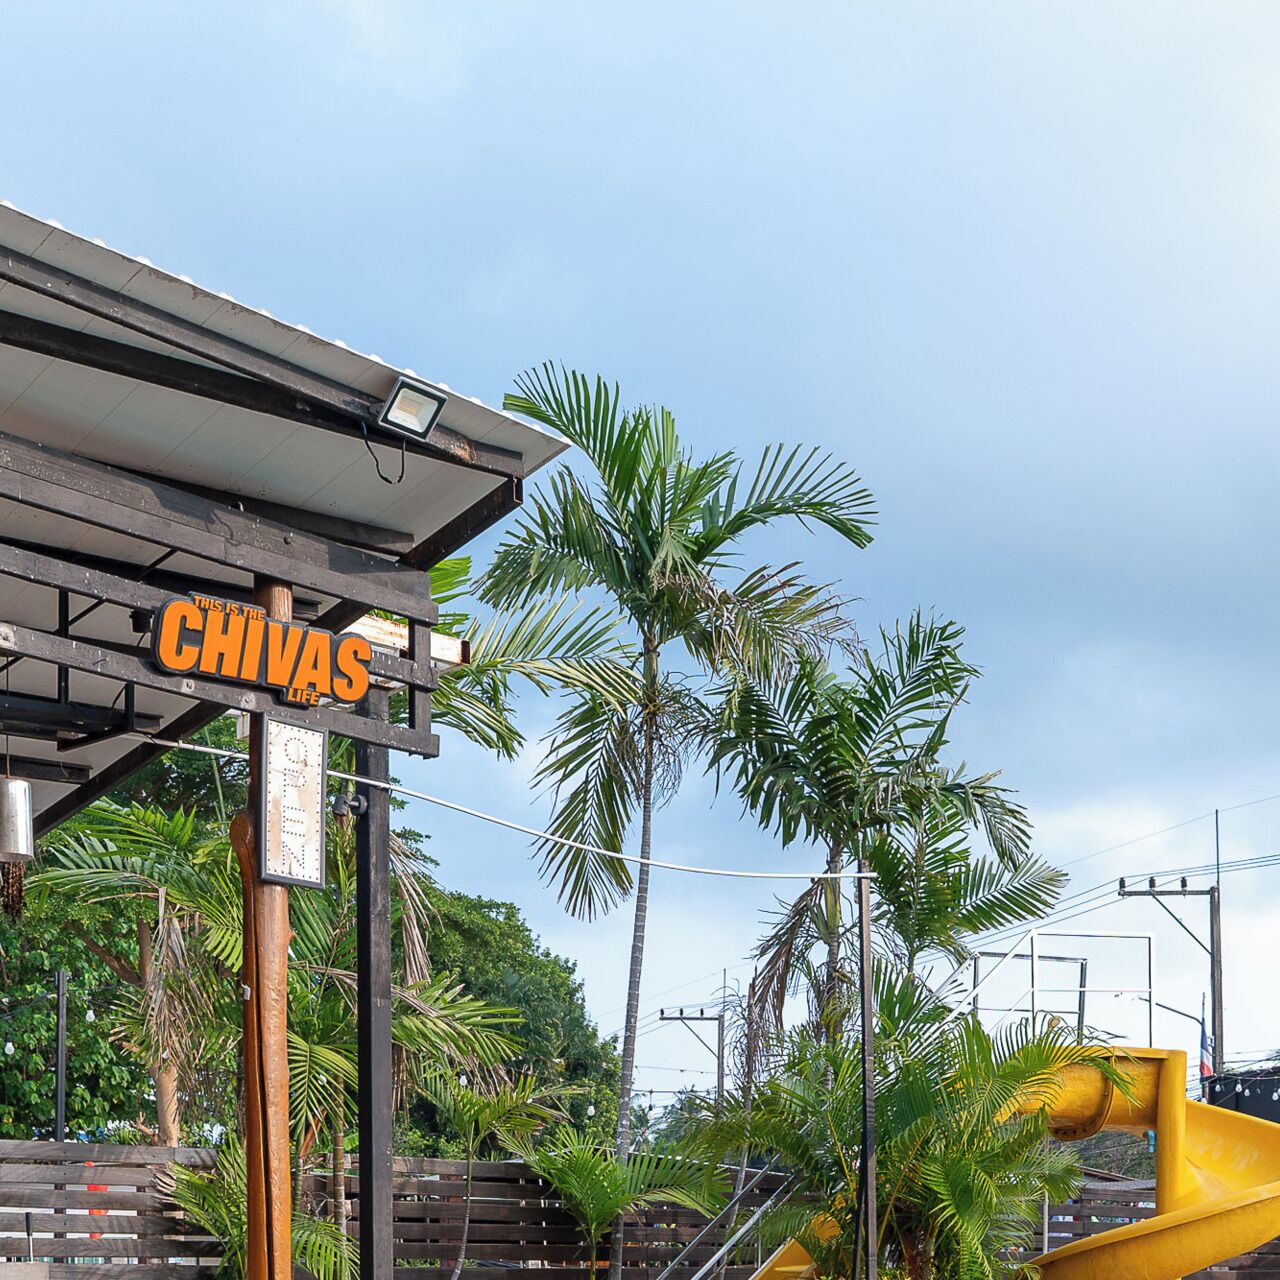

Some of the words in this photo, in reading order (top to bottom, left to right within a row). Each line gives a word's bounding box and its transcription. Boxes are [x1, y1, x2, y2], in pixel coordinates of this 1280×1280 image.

[193, 595, 222, 613] THIS
[225, 602, 240, 616] IS
[242, 606, 265, 621] THE
[158, 600, 372, 703] CHIVAS
[287, 687, 320, 706] LIFE
[282, 736, 309, 870] OPEN
